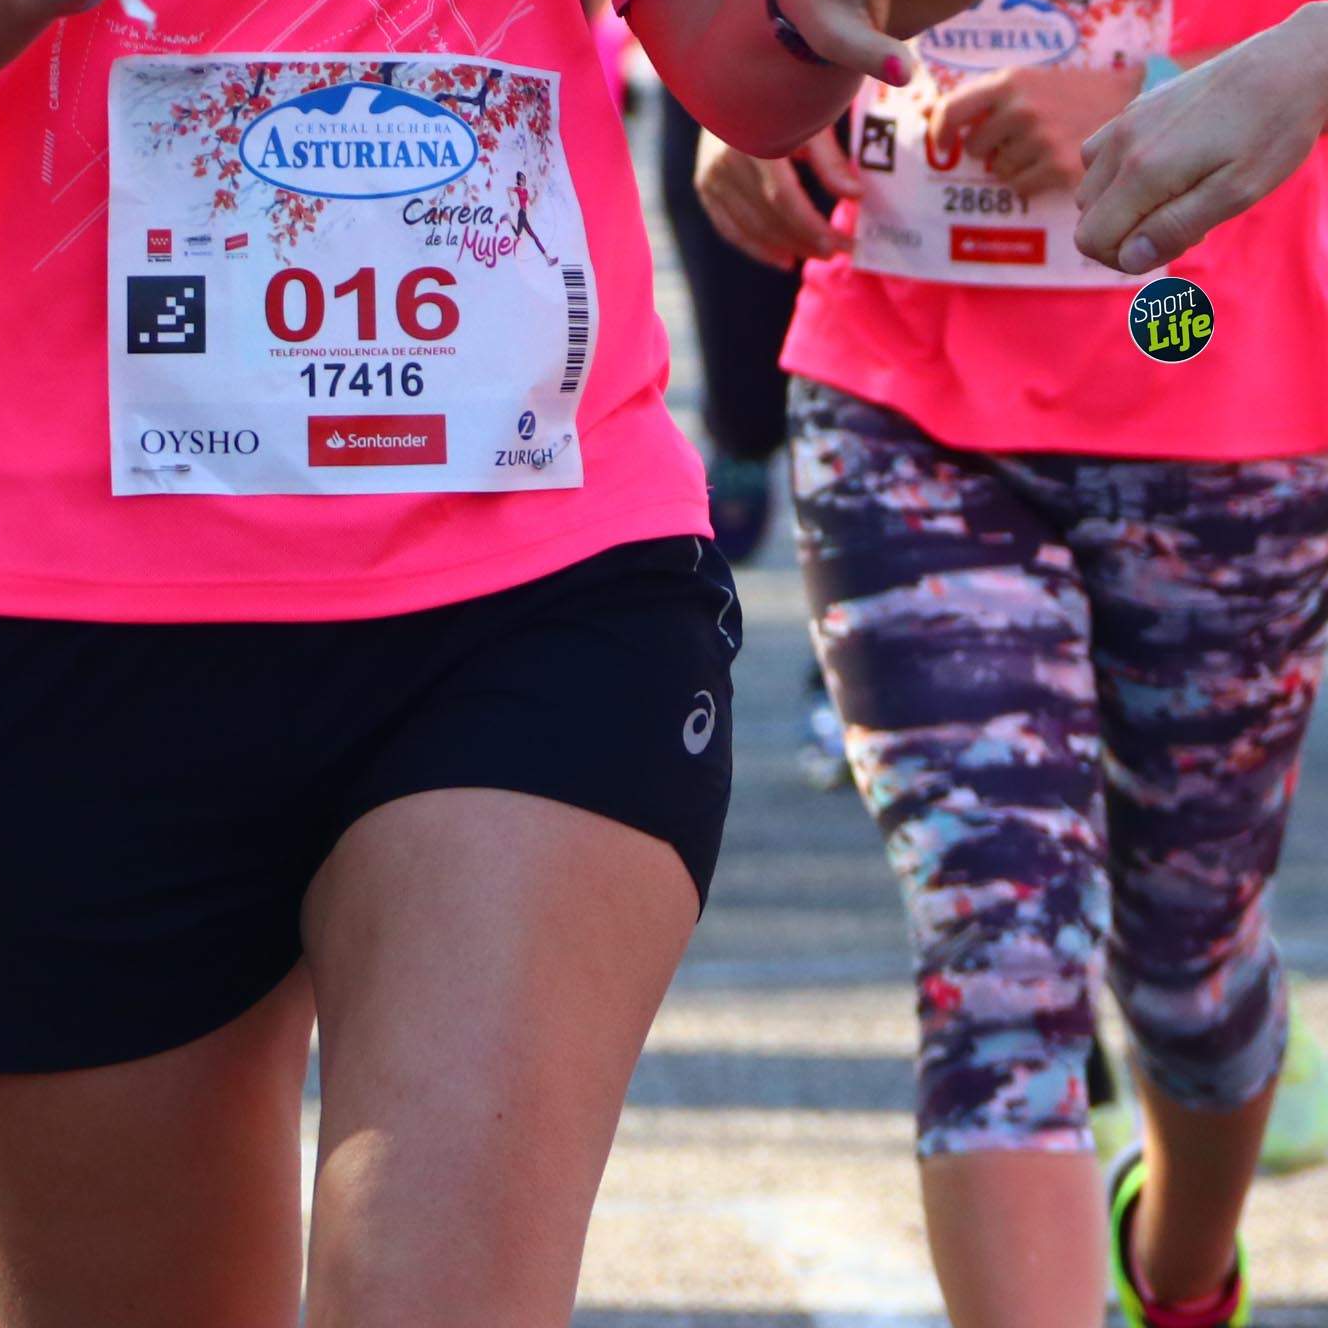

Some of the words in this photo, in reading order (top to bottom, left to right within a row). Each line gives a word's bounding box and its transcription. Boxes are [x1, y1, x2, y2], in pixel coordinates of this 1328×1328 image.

[920, 25, 1067, 52] ASTURIANA
[295, 122, 368, 134] CENTRAL
[376, 122, 452, 134] LECHERA
[258, 125, 462, 169] ASTURIANA
[402, 198, 494, 226] Carrera
[425, 227, 443, 247] de
[445, 227, 458, 247] la
[457, 223, 521, 269] Mujer
[265, 266, 460, 342] 016
[329, 346, 389, 357] VIOLENCIA
[392, 346, 407, 357] DE
[300, 361, 425, 398] 17416
[140, 429, 260, 456] OYSHO
[347, 431, 429, 449] Santander
[495, 447, 554, 468] ZURICH
